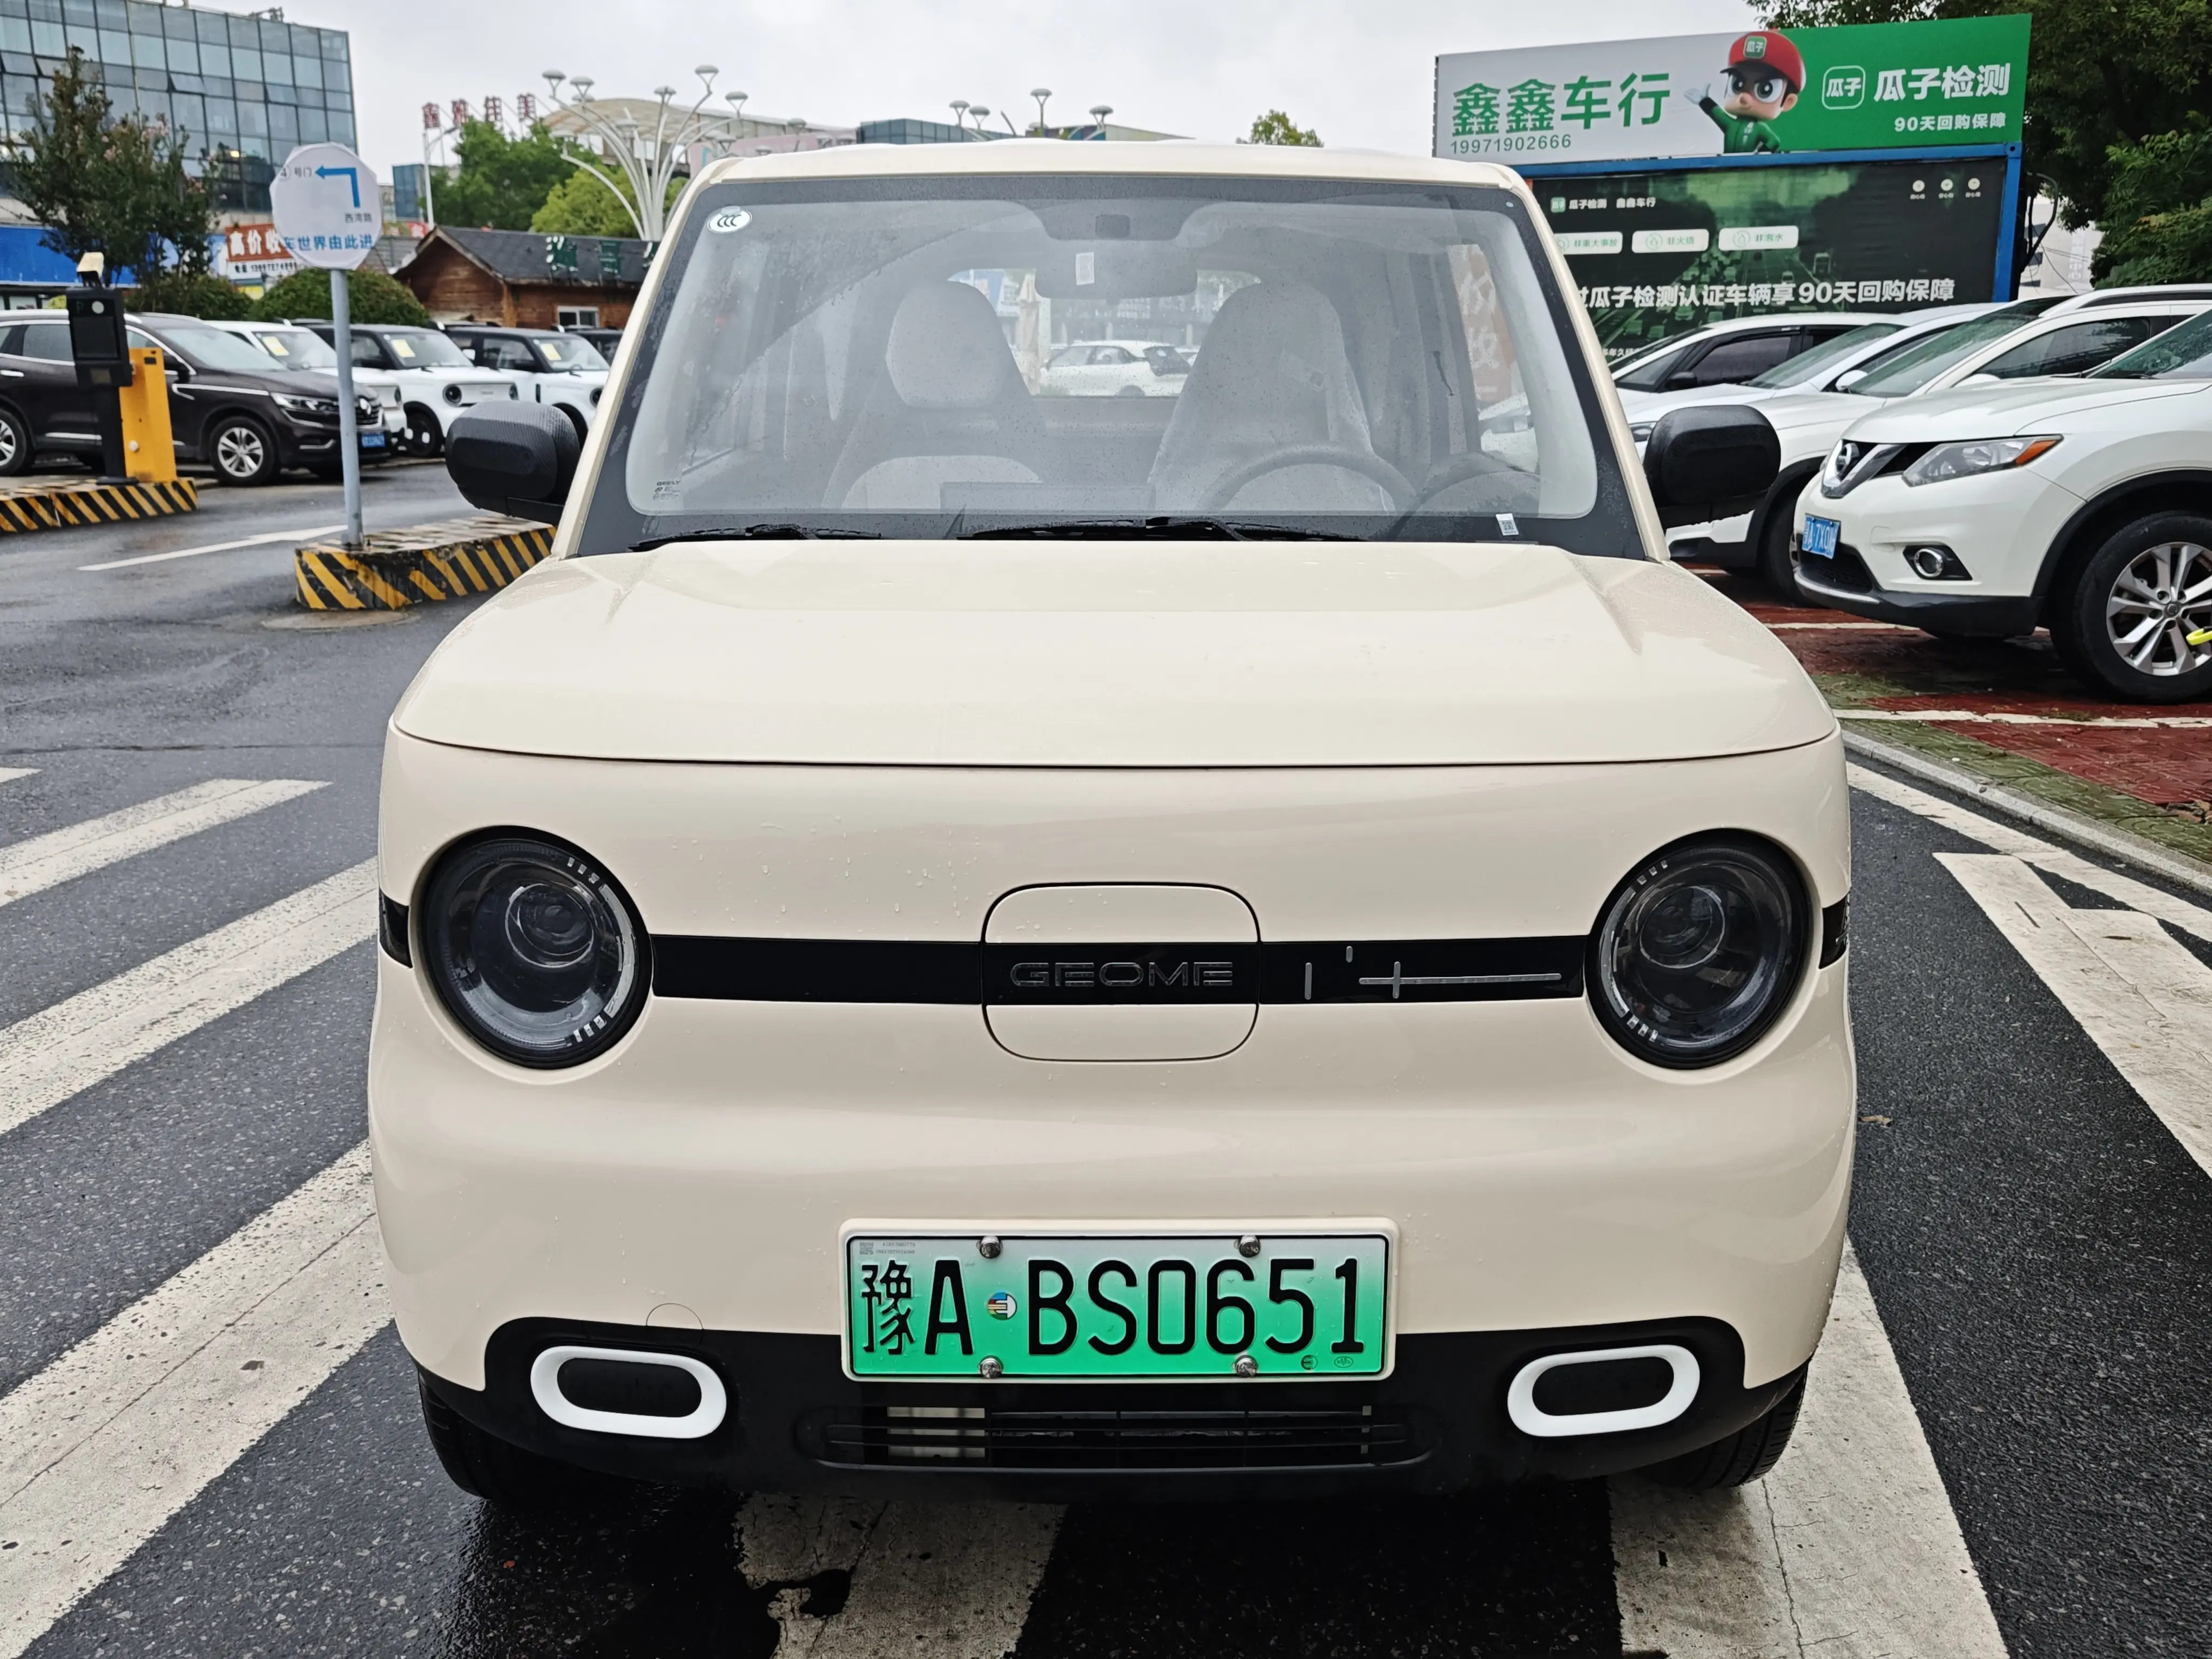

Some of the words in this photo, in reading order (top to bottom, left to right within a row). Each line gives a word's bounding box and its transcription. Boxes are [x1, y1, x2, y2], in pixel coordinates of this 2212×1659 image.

[1746, 41, 1764, 53] 瓜子
[1826, 77, 1862, 98] 瓜子
[1873, 63, 2011, 102] 瓜子检测
[1452, 72, 1671, 137] 鑫鑫车行
[1894, 112, 2007, 132] 90天回购保障
[1450, 133, 1572, 154] 19971902666
[1569, 198, 1607, 210] 瓜子检测
[1010, 962, 1234, 988] GEOME
